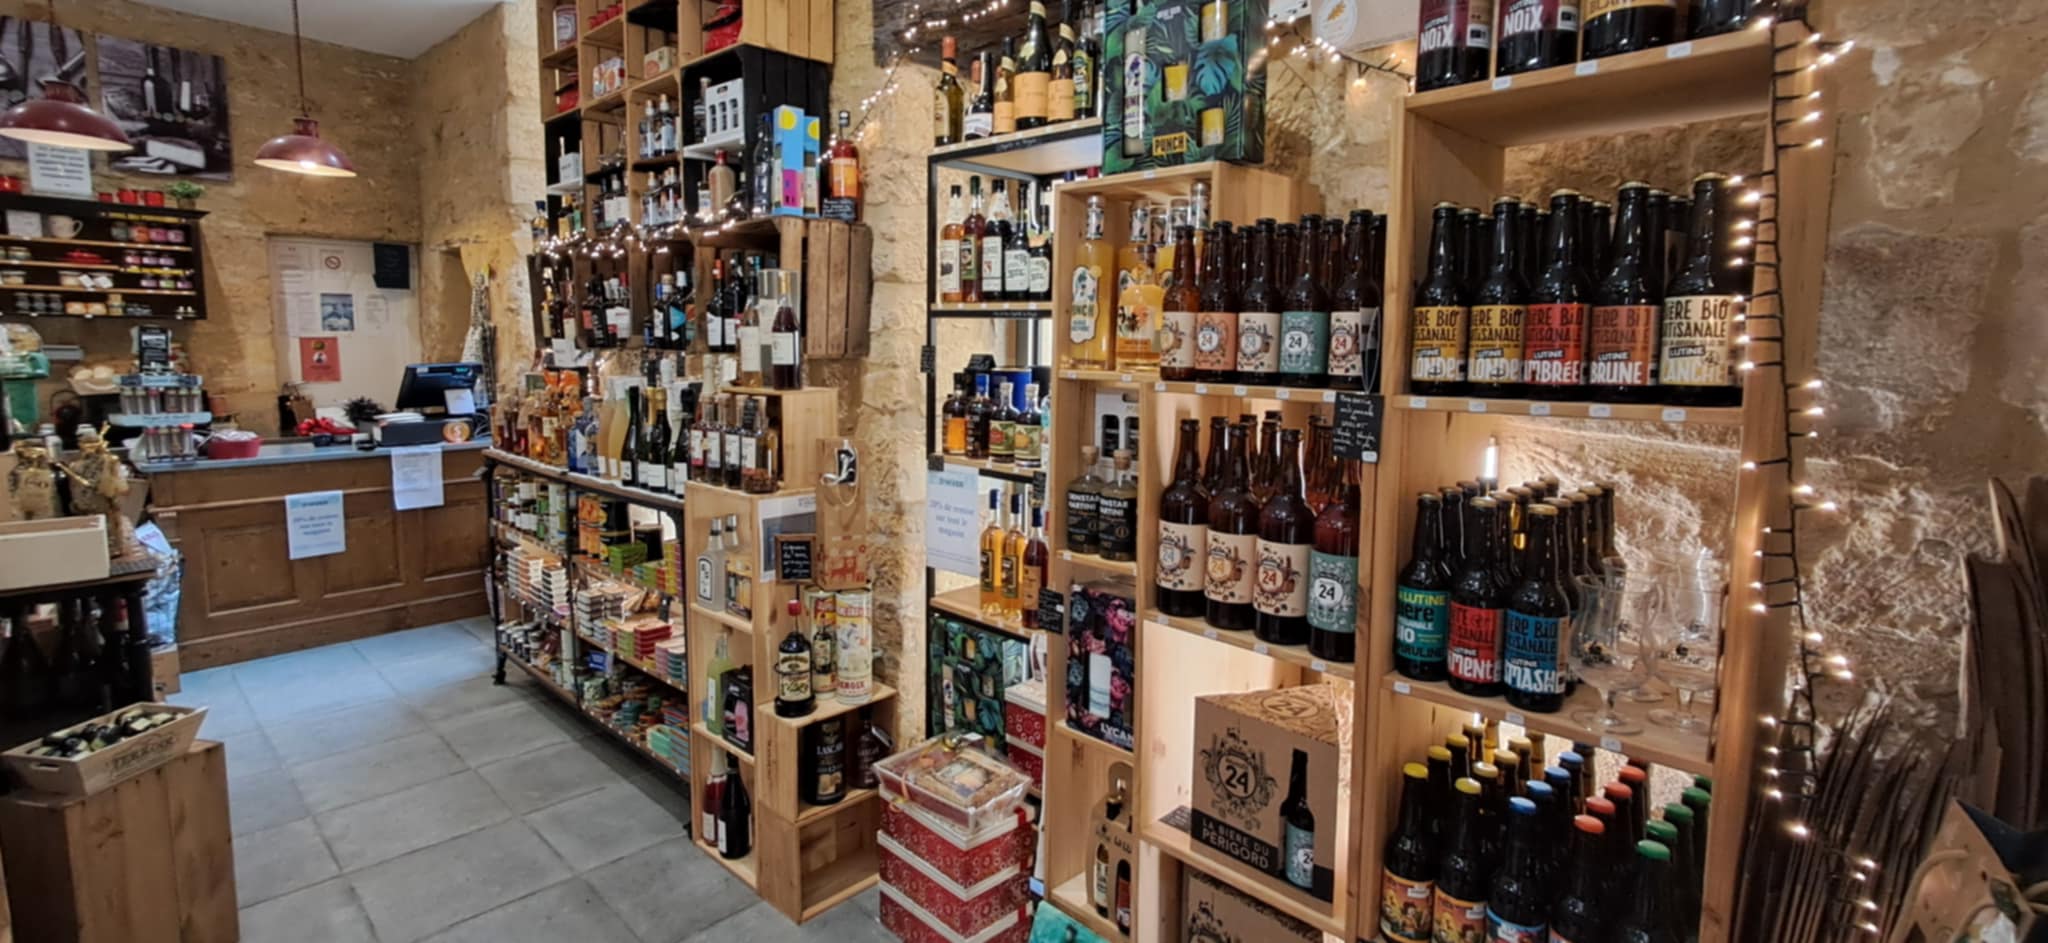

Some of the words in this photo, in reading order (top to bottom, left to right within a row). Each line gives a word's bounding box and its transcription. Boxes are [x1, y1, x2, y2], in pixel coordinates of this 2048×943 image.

[1155, 136, 1185, 152] PUNCH
[1288, 336, 1303, 349] 24
[1333, 337, 1347, 350] 24
[1590, 361, 1643, 384] BRUNE
[1262, 571, 1277, 586] 24
[1318, 583, 1335, 601] 24
[1225, 764, 1249, 794] 24
[1253, 842, 1270, 858] DU
